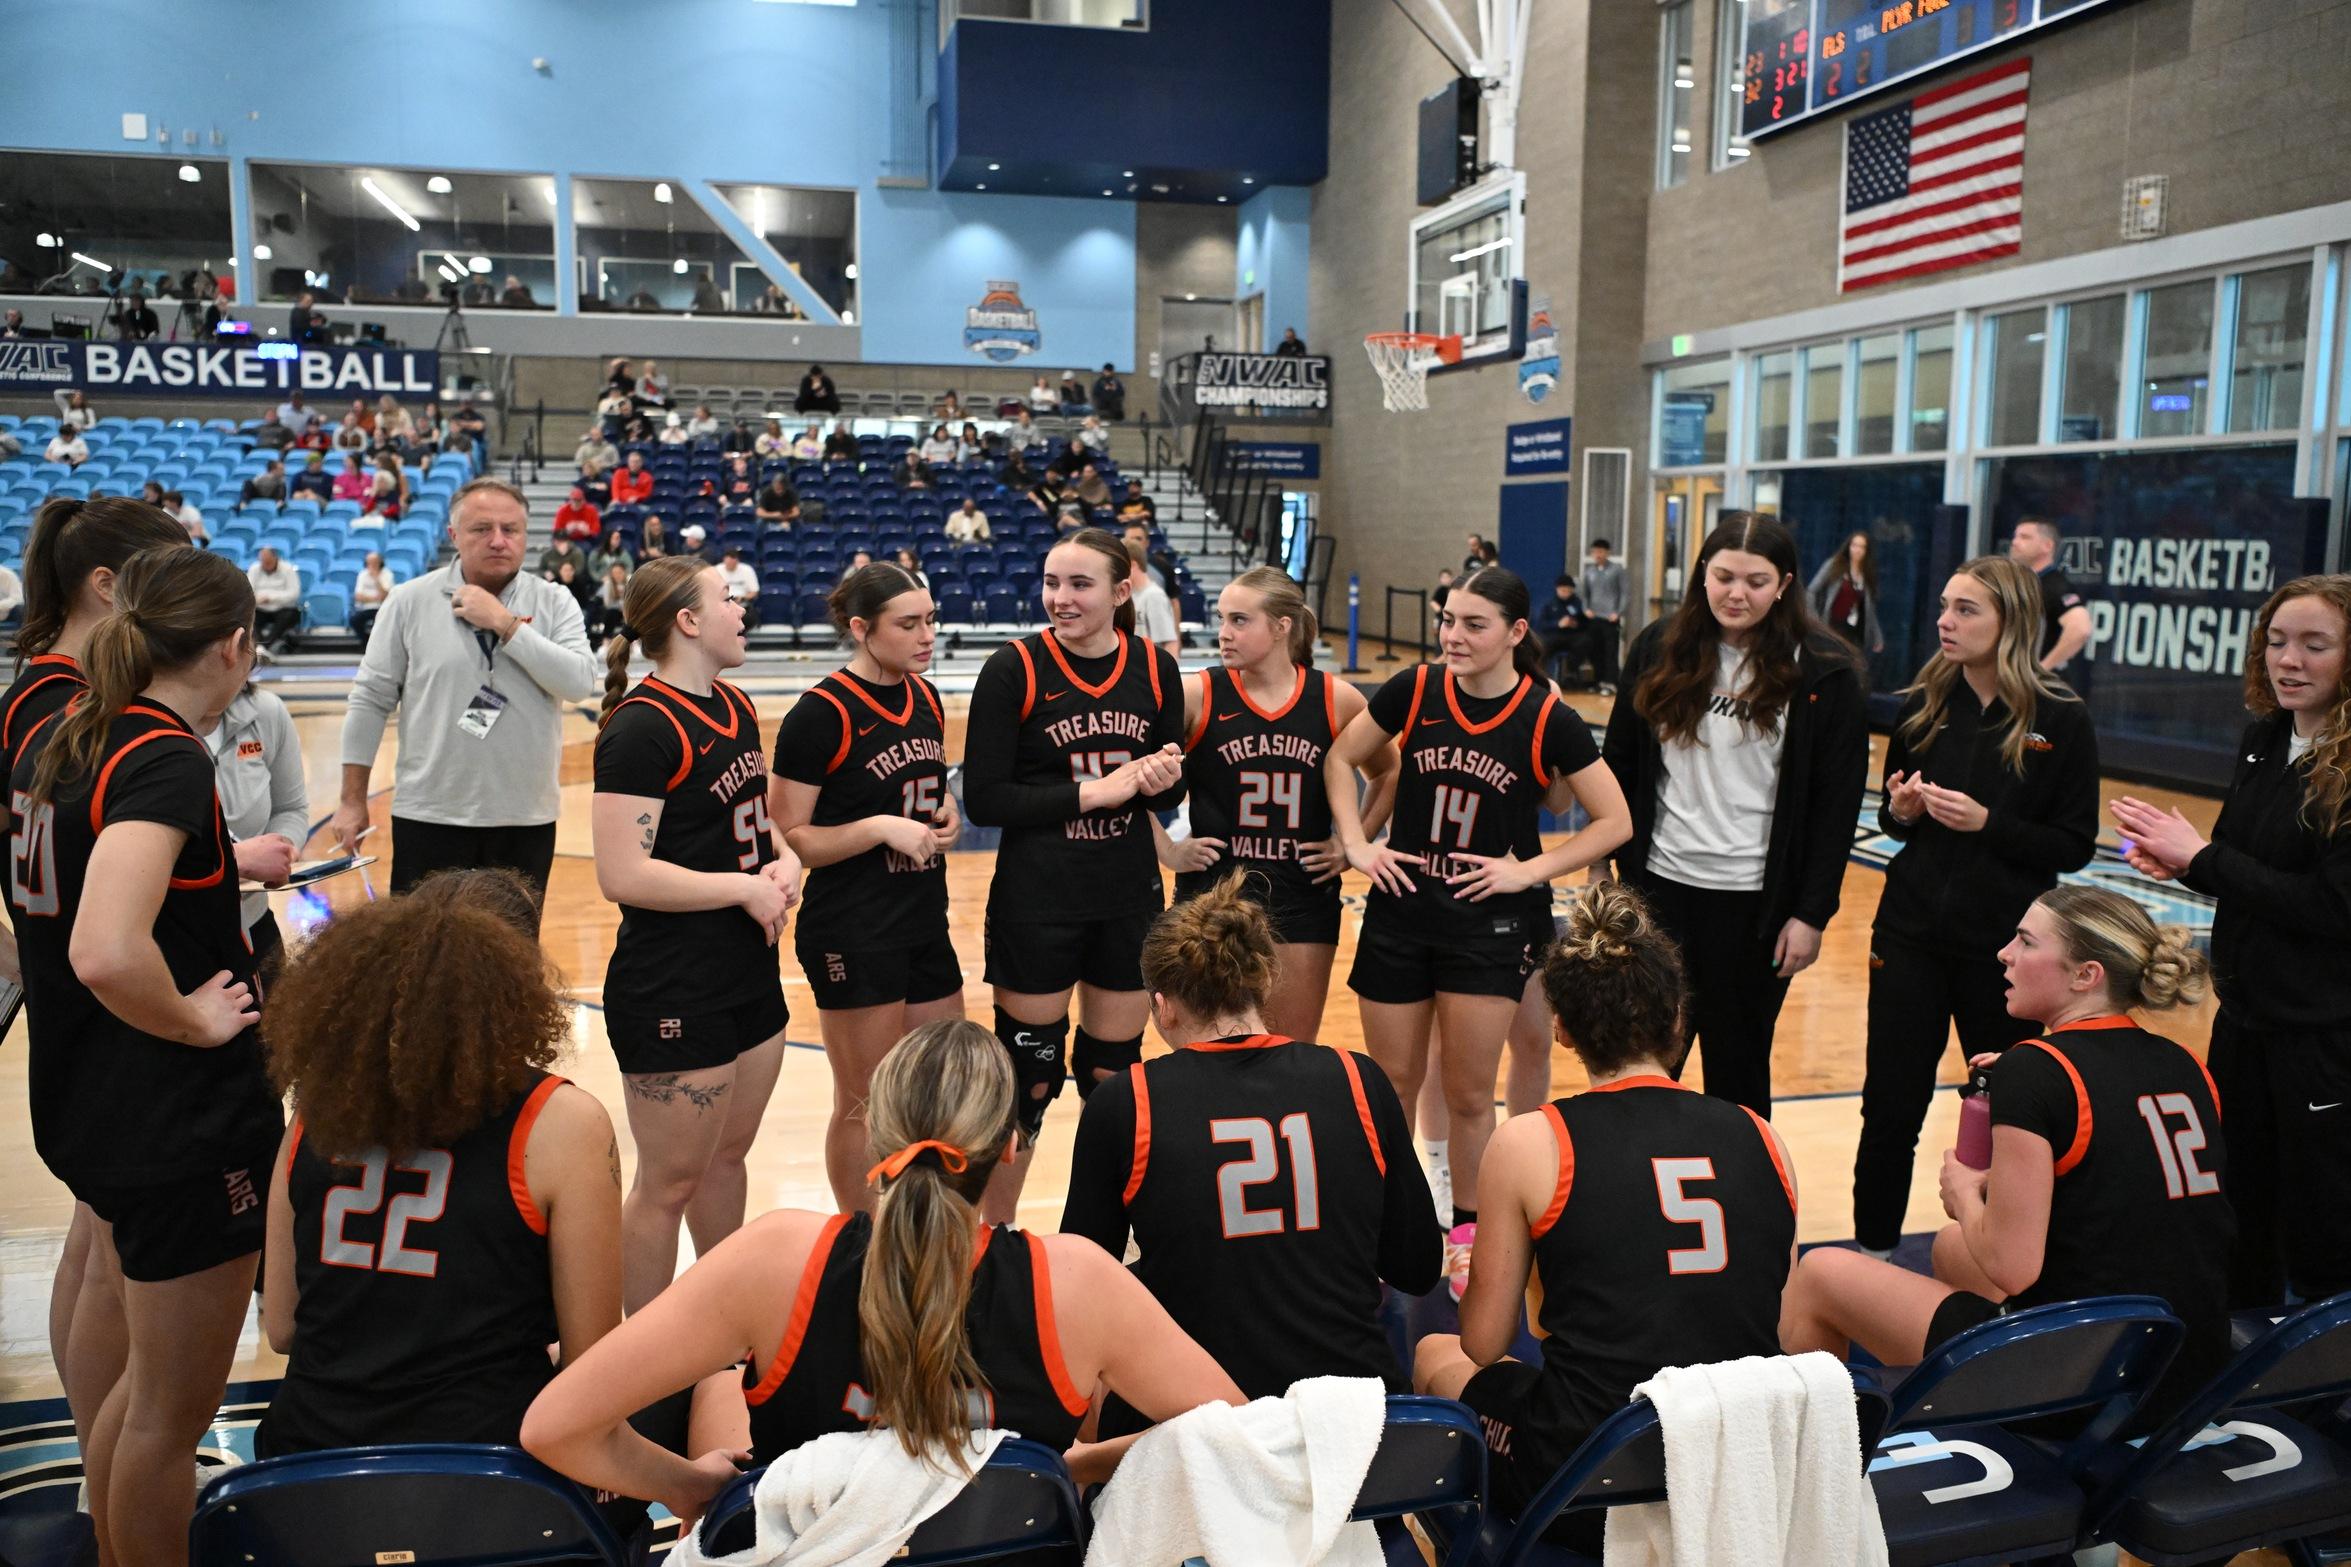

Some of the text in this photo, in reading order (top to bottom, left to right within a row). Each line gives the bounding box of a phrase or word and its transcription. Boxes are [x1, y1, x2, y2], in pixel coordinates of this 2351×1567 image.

[0, 343, 72, 373] AC
[85, 344, 433, 392] BASKETBALL
[1196, 355, 1327, 388] NWAC
[1195, 386, 1328, 409] CHAMPIONSHIPS
[2108, 537, 2275, 592] BASKETB
[2083, 600, 2260, 676] PIONSH
[1045, 711, 1150, 748] TREASURE
[1217, 734, 1322, 768] TREASURE
[1413, 746, 1518, 794] TREASURE
[902, 775, 939, 829] 15
[1065, 813, 1133, 841] VALLEY
[1238, 771, 1302, 829] 24
[1430, 784, 1480, 849] 14
[1231, 836, 1301, 861] VALLEY
[2137, 1092, 2221, 1199] 12
[1209, 1112, 1320, 1239] 21
[320, 1147, 454, 1278] 22
[1651, 1157, 1729, 1275] 5
